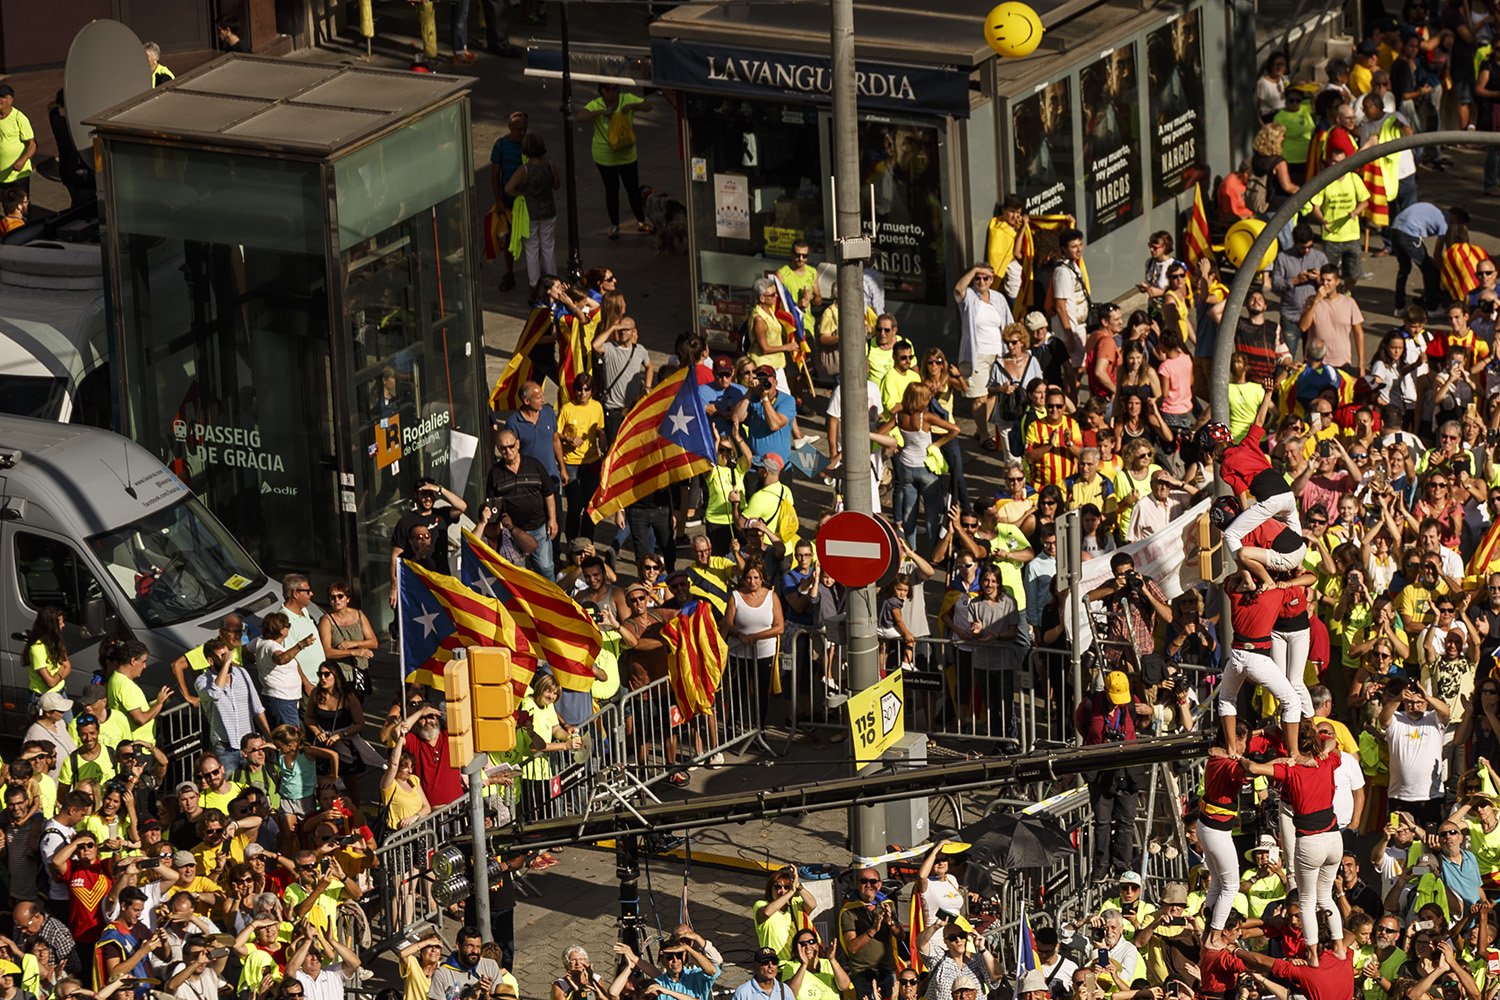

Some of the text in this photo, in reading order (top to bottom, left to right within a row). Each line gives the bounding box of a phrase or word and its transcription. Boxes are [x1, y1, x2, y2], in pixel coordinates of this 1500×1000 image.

[1161, 138, 1195, 174] NARCOS
[1095, 173, 1130, 211] NARCOS
[879, 233, 919, 246] puesto.
[883, 222, 926, 237] muerto,
[870, 251, 922, 276] ARCOS
[194, 423, 261, 448] PASSEIG
[403, 410, 450, 445] Rodalies
[403, 446, 412, 456] de
[412, 431, 441, 452] Catalunya
[197, 445, 285, 473] DE GRÀCIA
[273, 486, 299, 496] adif
[855, 711, 876, 734] 11S
[860, 728, 876, 749] 10
[807, 988, 817, 997] Sí
